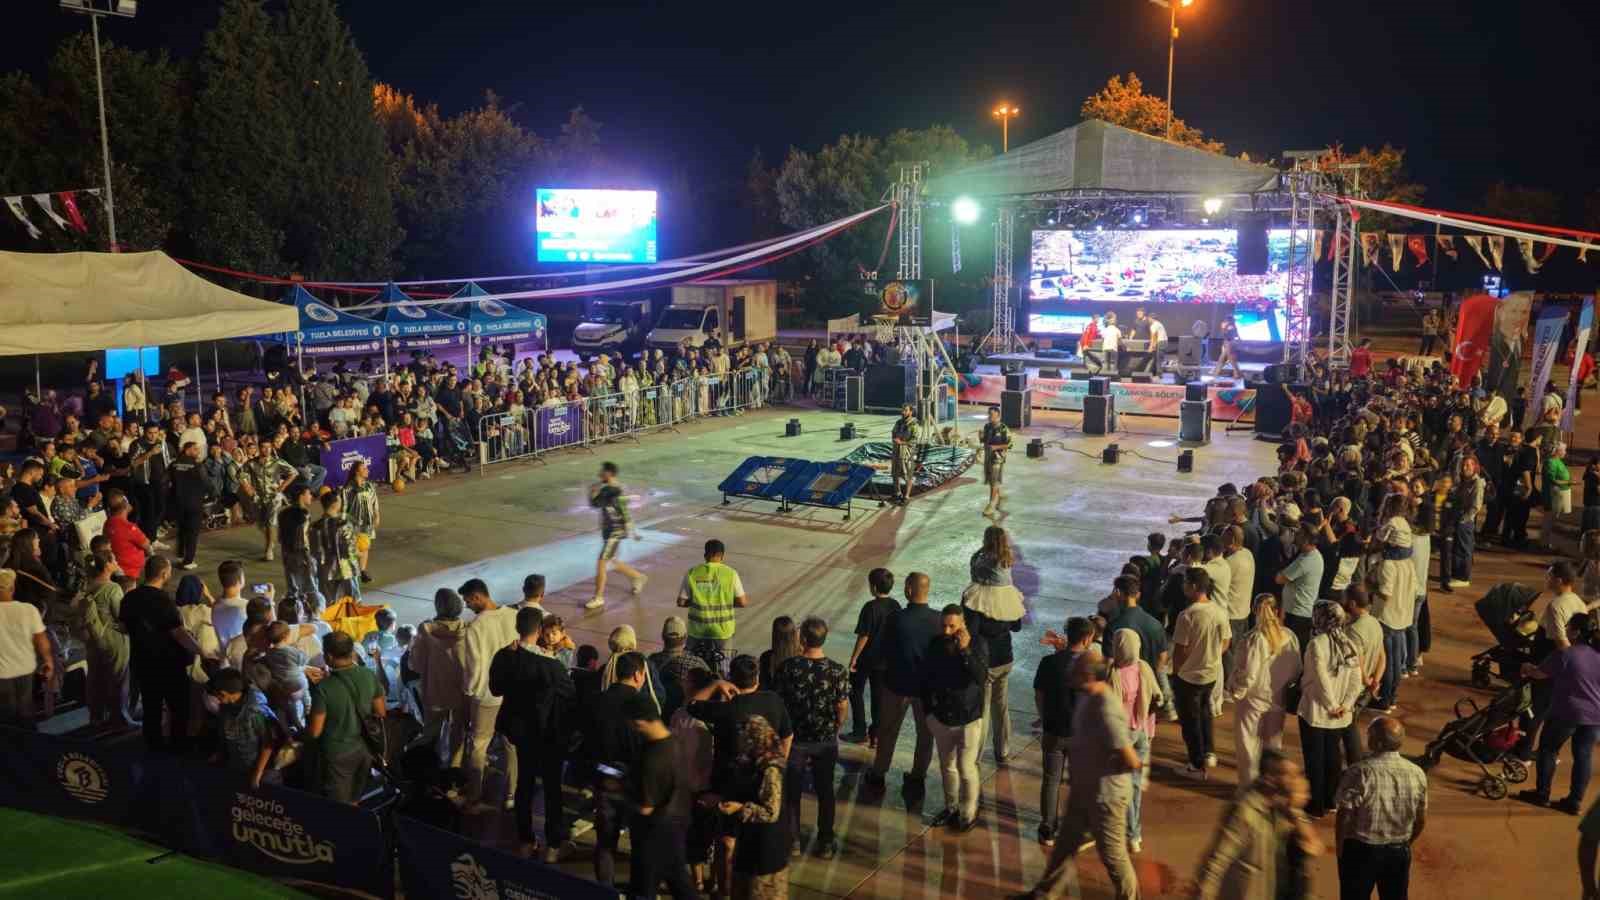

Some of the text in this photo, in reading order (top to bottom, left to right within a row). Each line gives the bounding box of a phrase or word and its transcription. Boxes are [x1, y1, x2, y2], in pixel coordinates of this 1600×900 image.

[311, 327, 369, 340] TUZLA BELEDİYESİ
[404, 325, 421, 334] TUZLA
[232, 792, 284, 814] sporla
[231, 806, 304, 836] geleceğe
[233, 822, 335, 864] umutla
